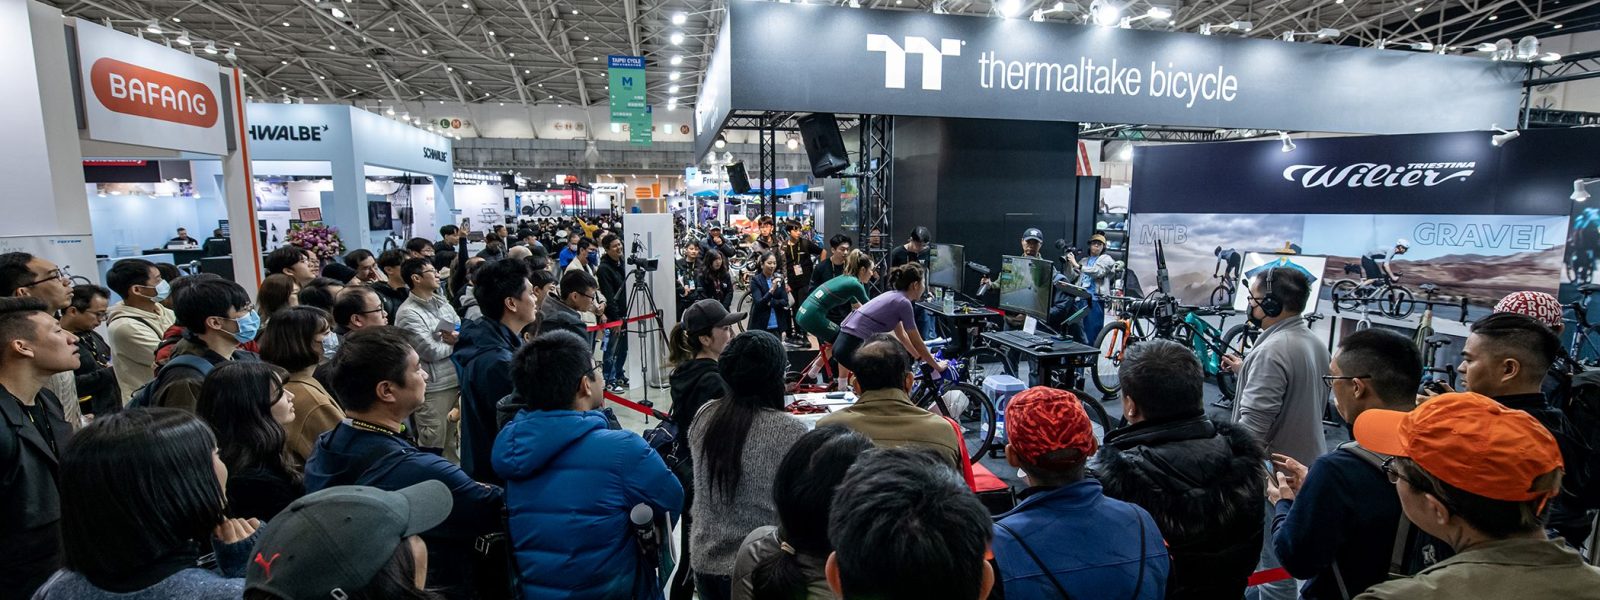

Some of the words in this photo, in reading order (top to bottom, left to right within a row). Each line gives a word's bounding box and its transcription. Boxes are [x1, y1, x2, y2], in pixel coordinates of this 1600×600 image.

[622, 76, 633, 87] M
[978, 51, 1142, 96] thermaltake
[1150, 61, 1238, 108] bicycle
[109, 72, 207, 115] BAFANG
[423, 147, 447, 162] SCHWALBE
[1407, 161, 1476, 169] TRIESTINA
[1283, 163, 1475, 188] Wilier
[1139, 224, 1188, 245] MTB
[1413, 222, 1554, 250] GRAVEL
